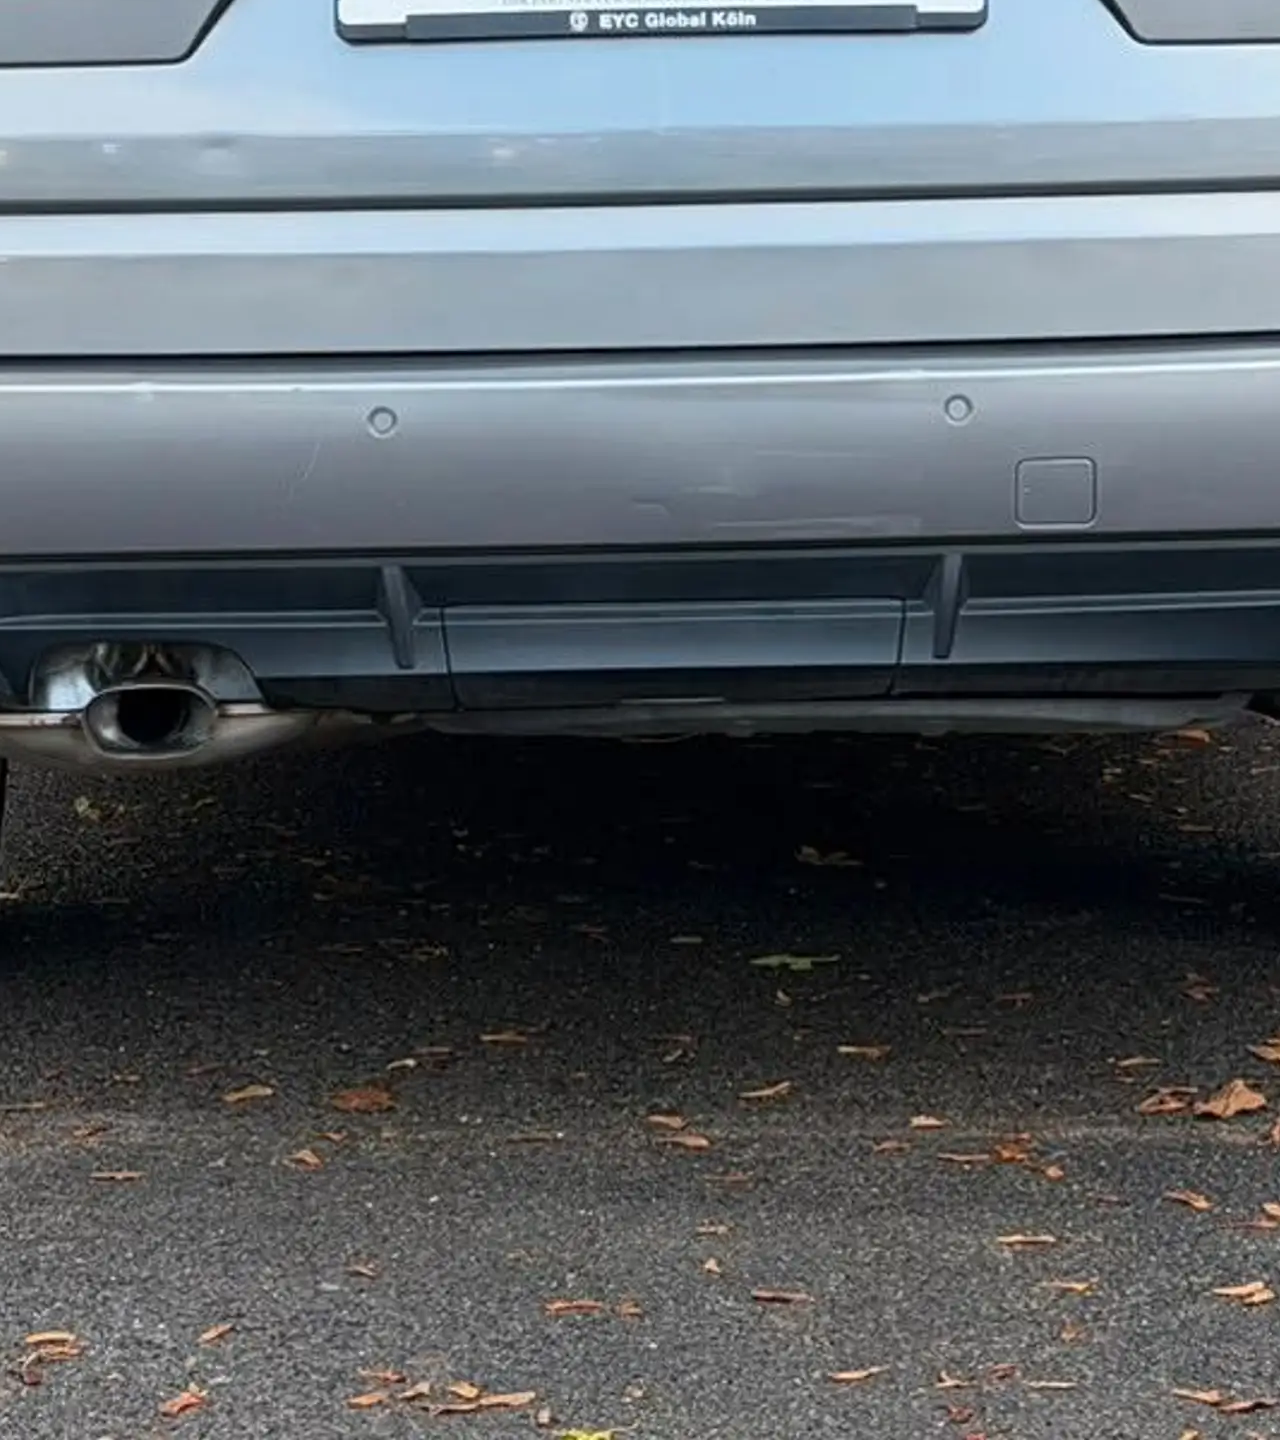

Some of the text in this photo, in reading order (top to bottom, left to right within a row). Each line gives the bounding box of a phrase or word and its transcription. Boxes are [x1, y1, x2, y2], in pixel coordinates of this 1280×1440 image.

[598, 10, 758, 29] EYC Global Köln
